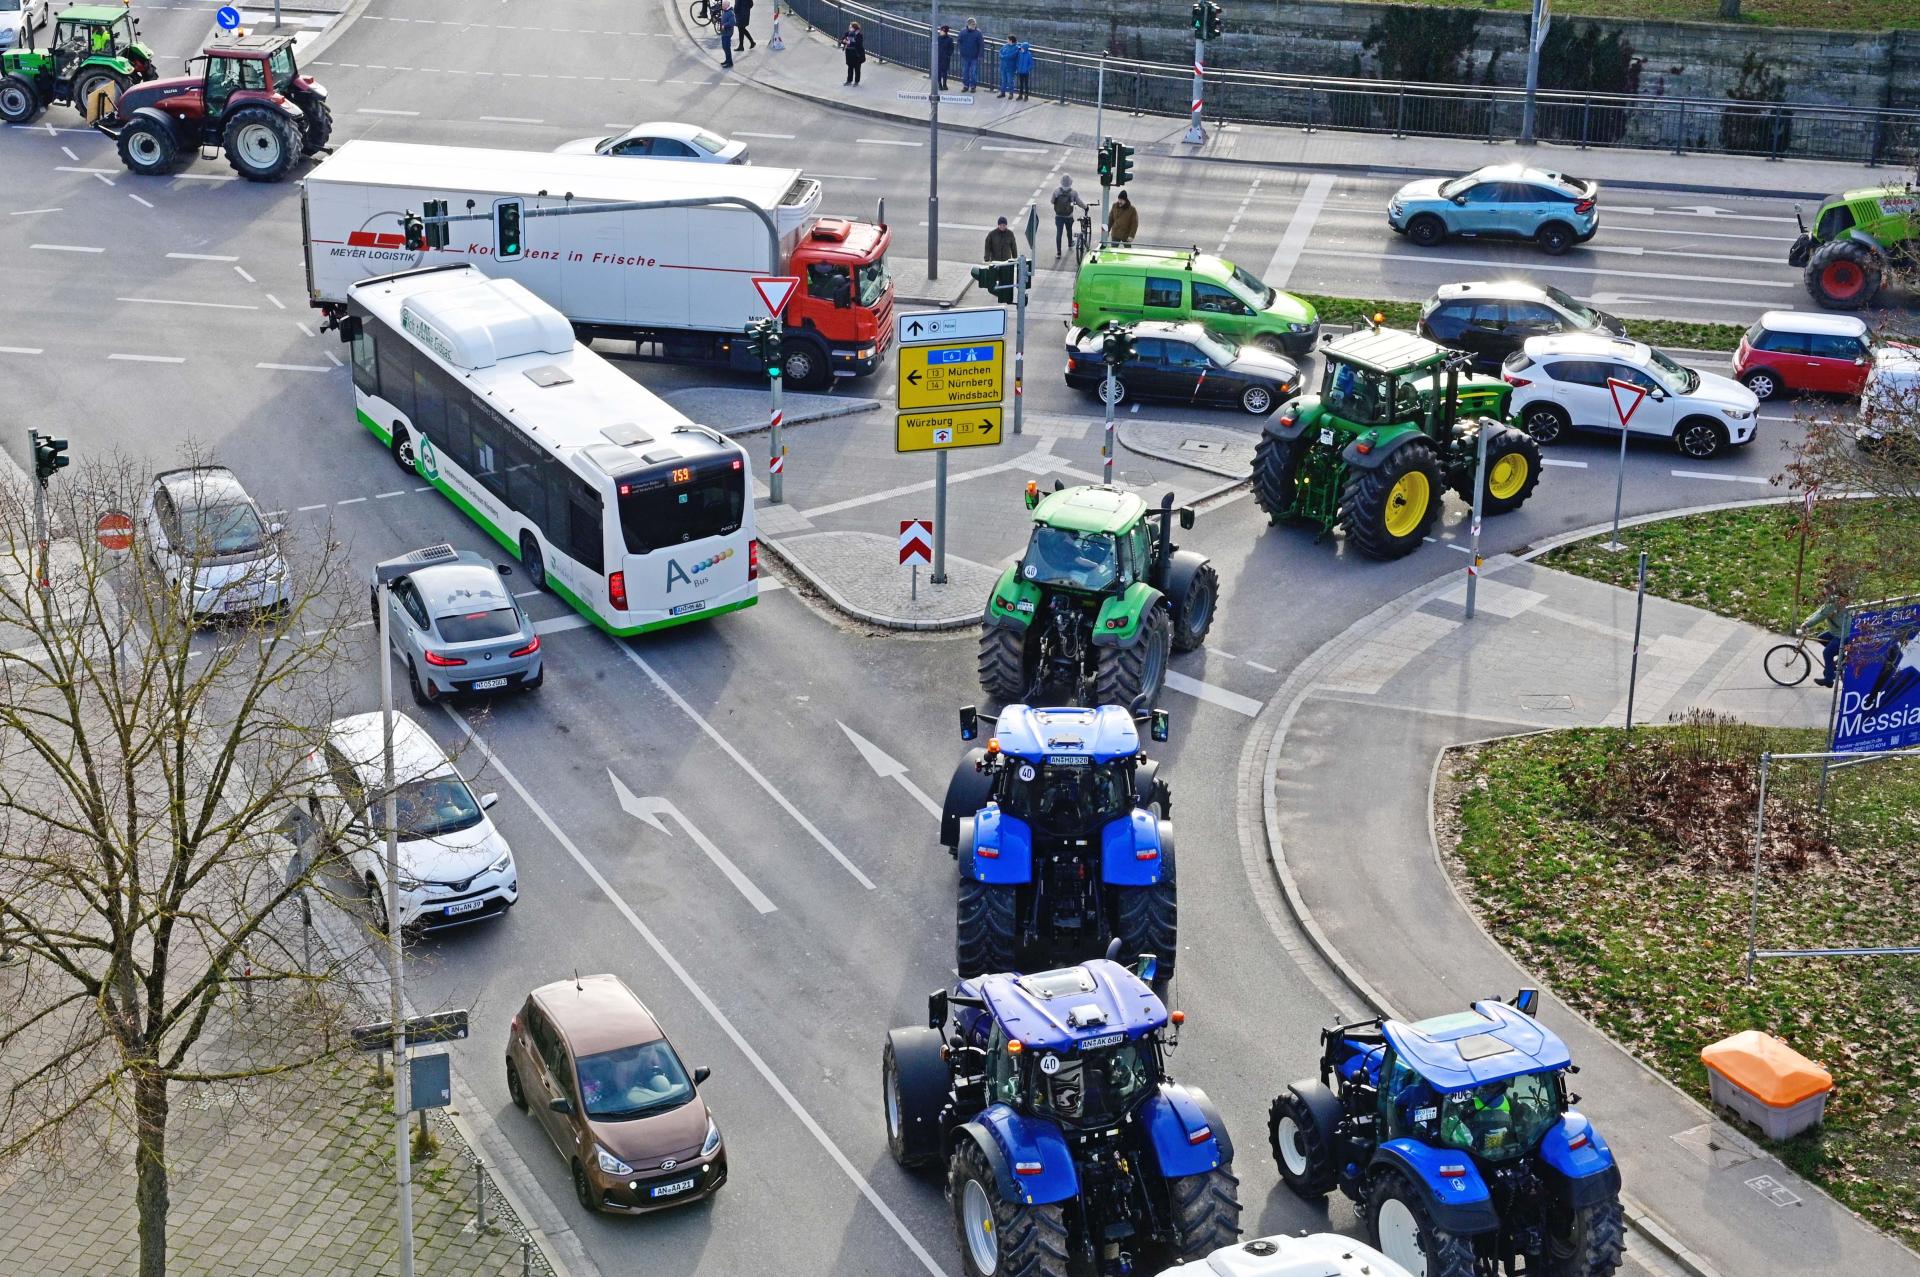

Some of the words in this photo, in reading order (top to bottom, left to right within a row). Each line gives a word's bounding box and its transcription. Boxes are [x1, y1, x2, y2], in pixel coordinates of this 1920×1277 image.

[330, 248, 366, 258] MEYER
[368, 249, 416, 262] LOGISTIK
[567, 250, 583, 262] in
[592, 252, 656, 267] Frische
[949, 352, 954, 360] 6
[948, 366, 991, 377] München
[948, 378, 993, 388] Nürnberg
[948, 390, 999, 400] Windsbach
[906, 418, 953, 428] Würzburg
[961, 424, 969, 432] 13
[671, 467, 689, 482] 759
[666, 558, 692, 594] A
[693, 577, 709, 588] Bus
[1842, 690, 1886, 715] Der
[1021, 767, 1032, 779] 40
[1044, 1058, 1056, 1070] 40
